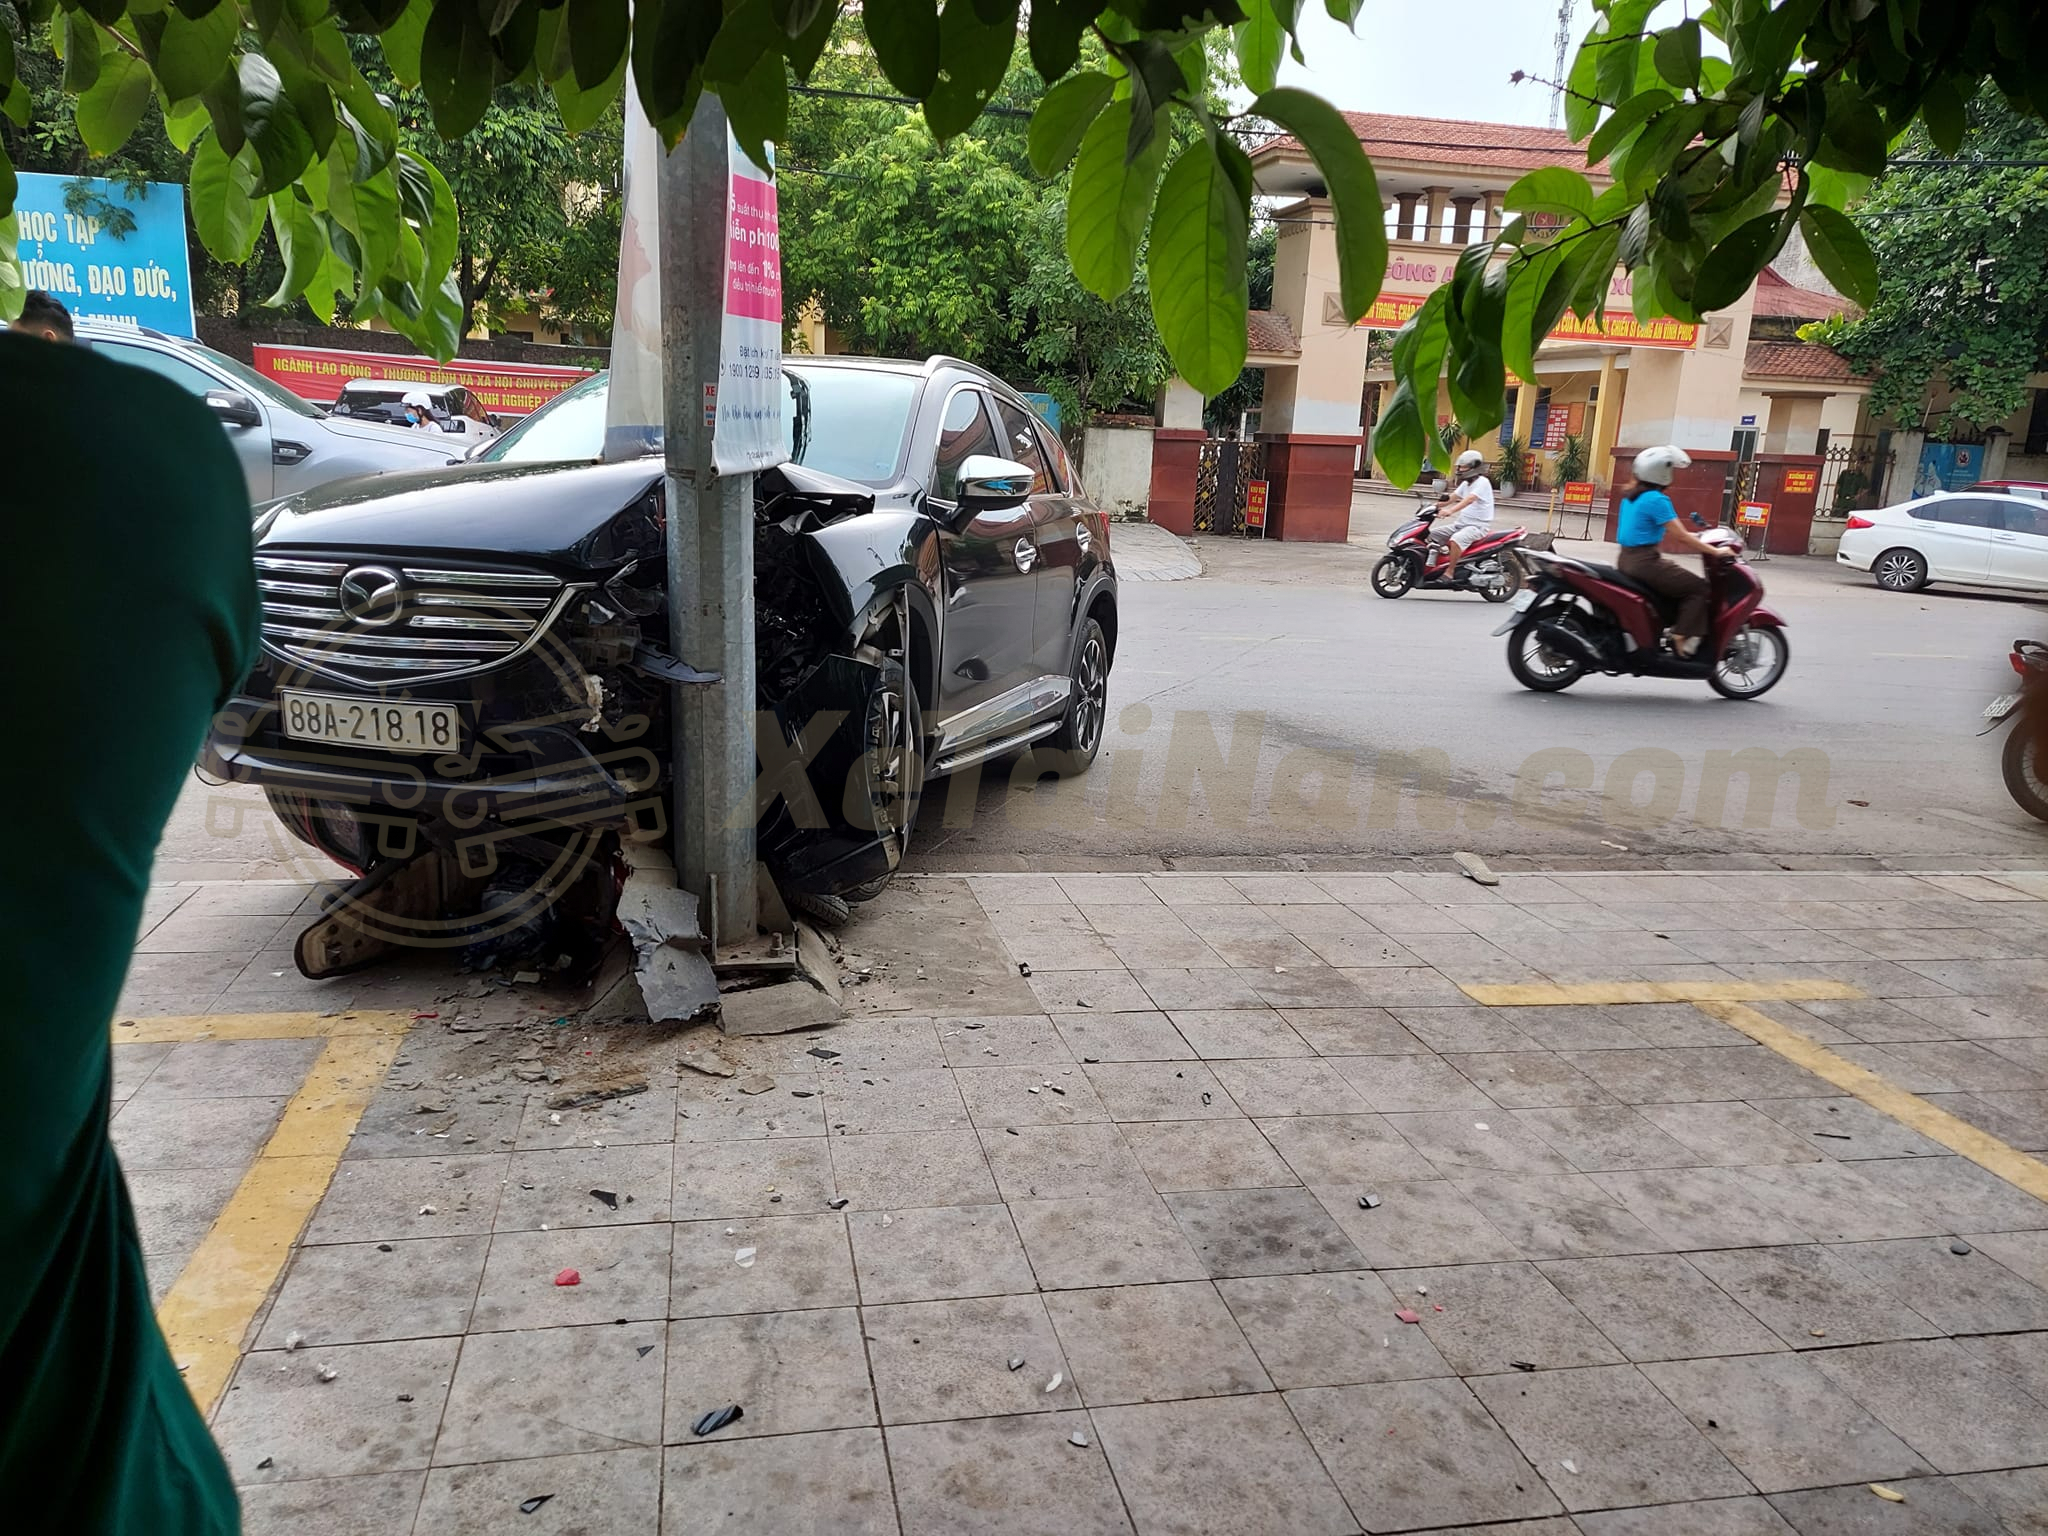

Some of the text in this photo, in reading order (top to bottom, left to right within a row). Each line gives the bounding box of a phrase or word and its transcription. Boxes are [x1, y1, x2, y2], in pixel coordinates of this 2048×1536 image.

[17, 210, 57, 249] HỌC
[22, 249, 177, 302] ƯỞNG, ĐẠO ĐỨC,
[273, 357, 313, 374] NGÀNH
[316, 362, 337, 376] LAO
[341, 363, 371, 379] ĐỘNG
[502, 393, 542, 410] NGHIỆP
[289, 698, 450, 746] 88A-218.18
